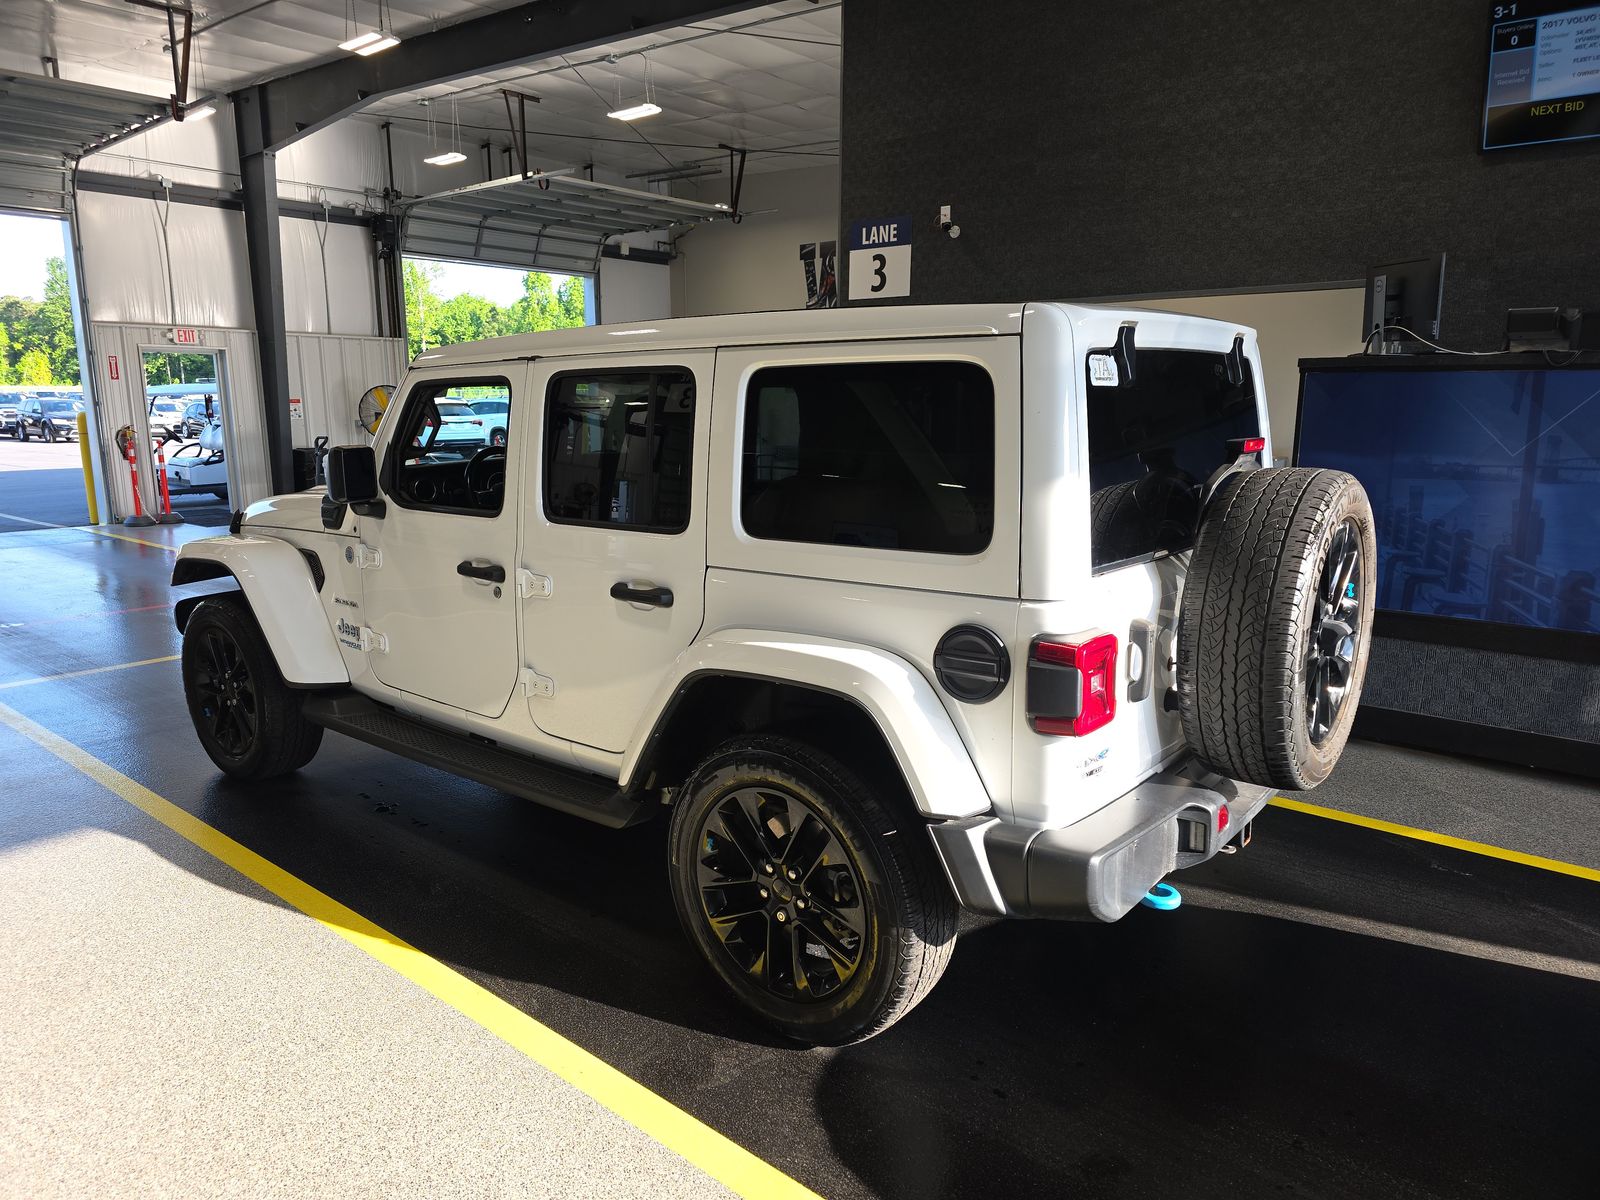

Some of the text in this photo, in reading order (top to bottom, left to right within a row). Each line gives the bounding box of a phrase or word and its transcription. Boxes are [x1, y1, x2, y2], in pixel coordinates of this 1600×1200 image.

[1494, 4, 1517, 19] 3-1
[1542, 14, 1596, 30] 2017 VOLVO
[1510, 35, 1518, 46] 0
[1530, 100, 1585, 117] NEXT BID
[862, 223, 898, 245] LANE
[870, 253, 887, 293] 3
[177, 329, 195, 343] EXIT
